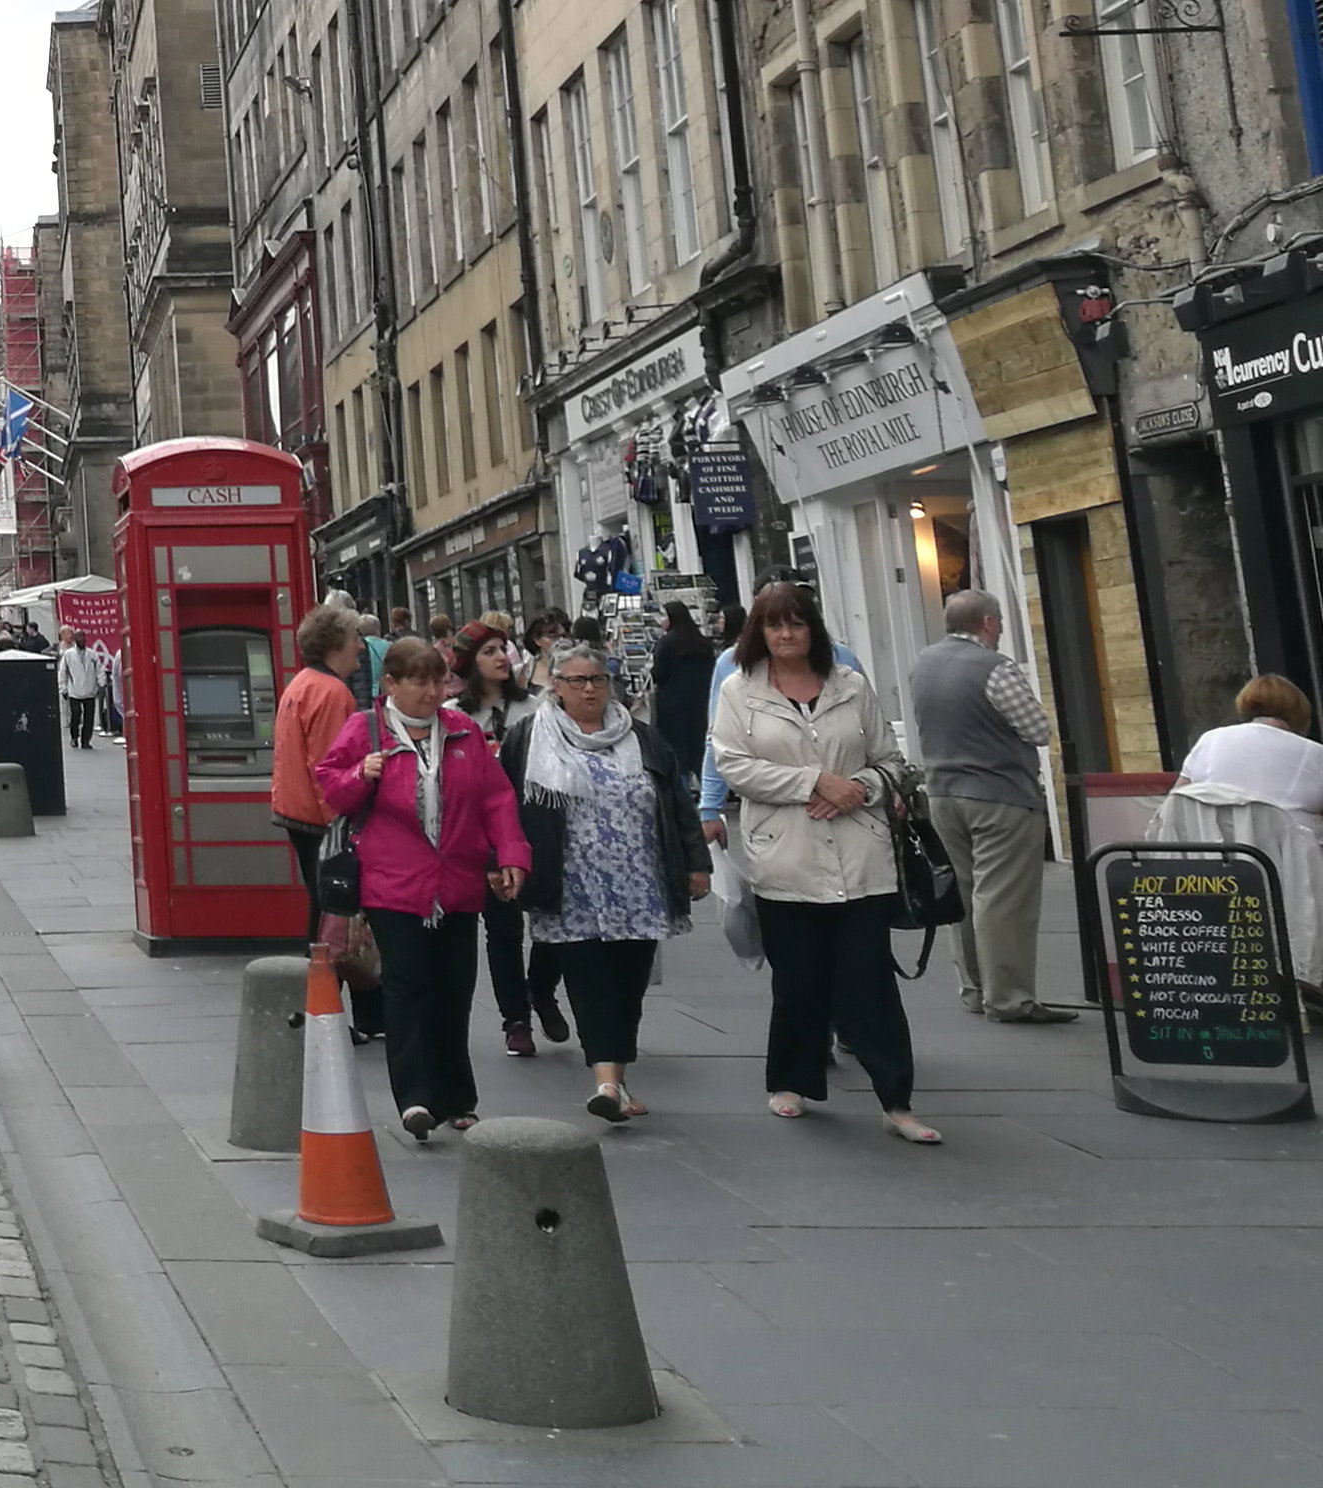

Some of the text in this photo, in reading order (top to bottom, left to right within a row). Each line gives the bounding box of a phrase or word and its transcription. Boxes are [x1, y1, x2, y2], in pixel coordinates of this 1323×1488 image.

[780, 362, 929, 444] HOUSE OF EDINBURGH
[1172, 408, 1194, 426] CLOSE
[817, 413, 922, 469] THE ROYAL MILE
[692, 455, 746, 463] PURVEYORS
[716, 465, 738, 473] FINE
[699, 475, 743, 483] SCOTTISH
[698, 485, 747, 493] CASHMERE
[187, 487, 243, 504] CASH
[714, 495, 735, 503] AND
[707, 506, 744, 514] TWEEDS
[1132, 875, 1238, 894] HOT DRINKS
[1135, 897, 1164, 908] TEA
[1137, 910, 1203, 922] ESPRESSO
[1139, 925, 1179, 937] BLACK
[1183, 925, 1227, 937] COFFEE
[1141, 941, 1177, 953] WHITE
[1181, 941, 1228, 954] COFFEE
[1144, 957, 1186, 968] LATTE
[1145, 973, 1217, 986] CAPPUCCINO
[1149, 991, 1176, 1002] HOT
[1179, 991, 1247, 1005] CHOCOLATE
[1153, 1007, 1199, 1020] MOCHA
[1149, 1026, 1172, 1040] SIT
[1178, 1027, 1193, 1040] IN
